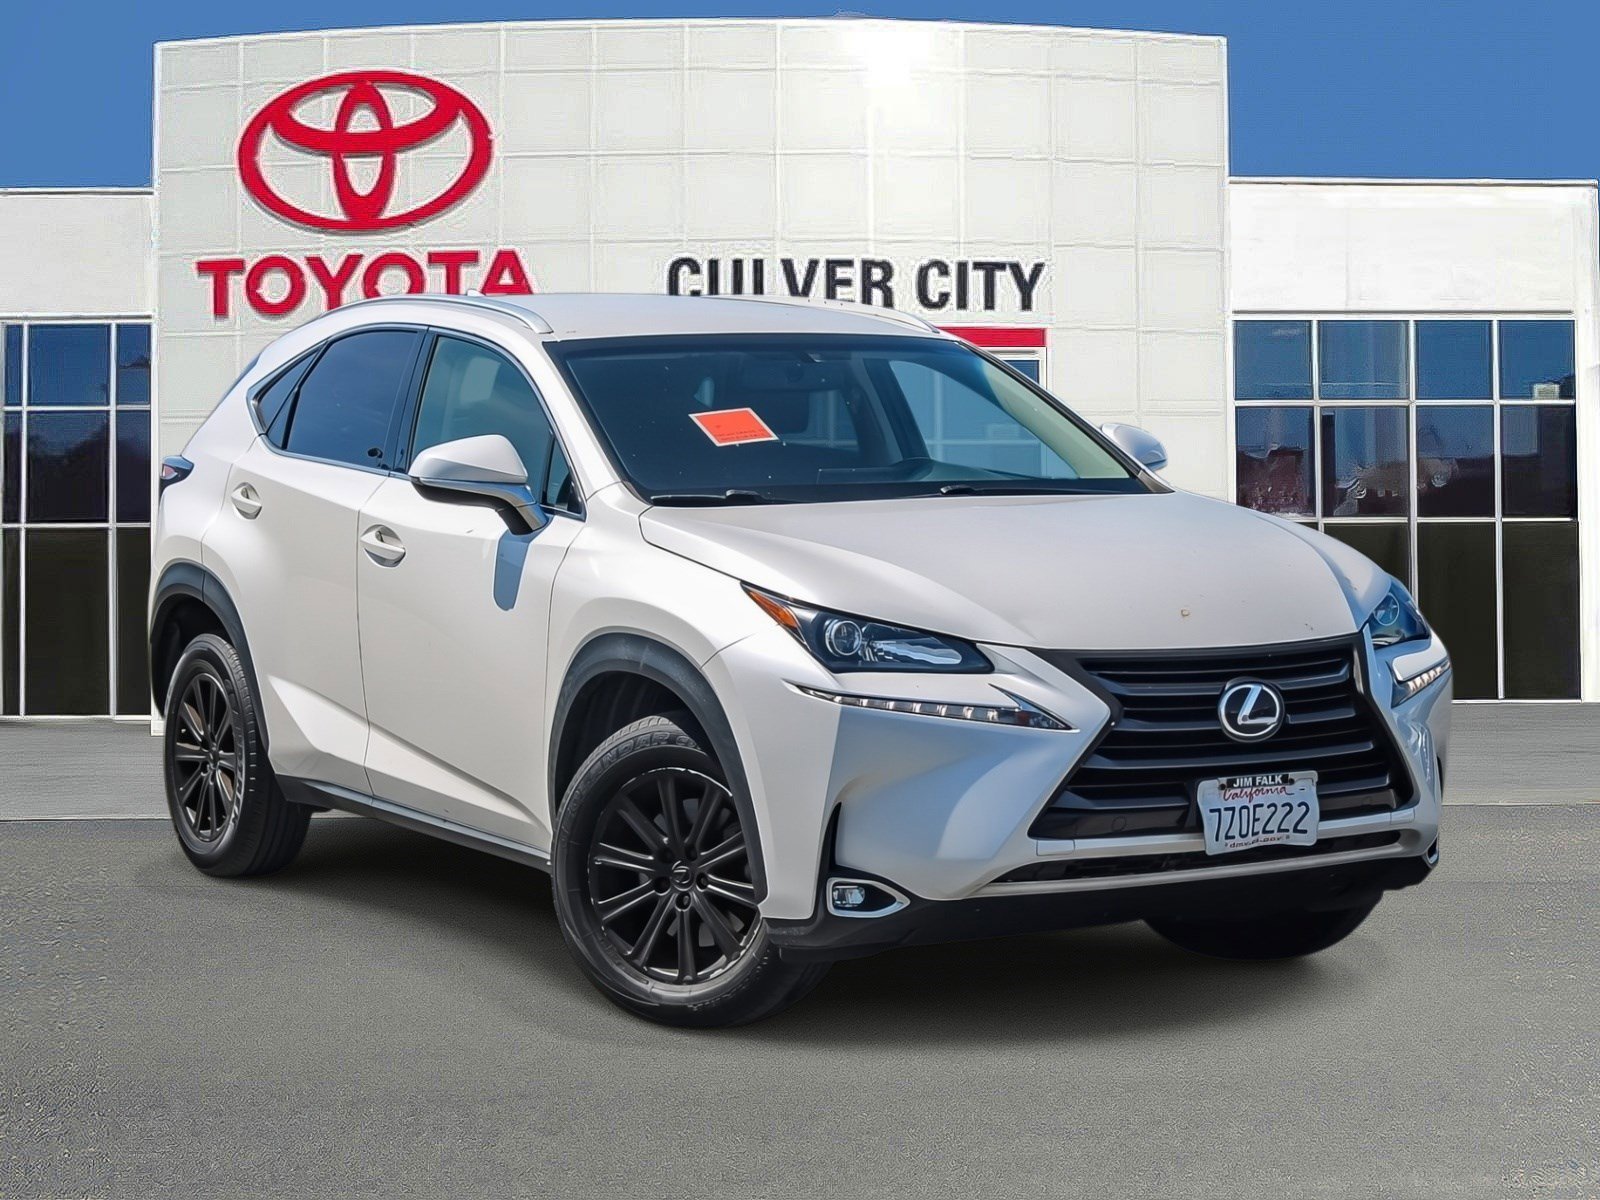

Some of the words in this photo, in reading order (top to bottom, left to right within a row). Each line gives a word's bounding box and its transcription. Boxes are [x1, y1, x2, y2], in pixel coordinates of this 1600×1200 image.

[195, 249, 535, 319] TOYOTA
[917, 258, 1046, 311] CITY
[1223, 786, 1294, 803] California
[1233, 777, 1253, 788] JIM
[1256, 775, 1283, 786] FALK
